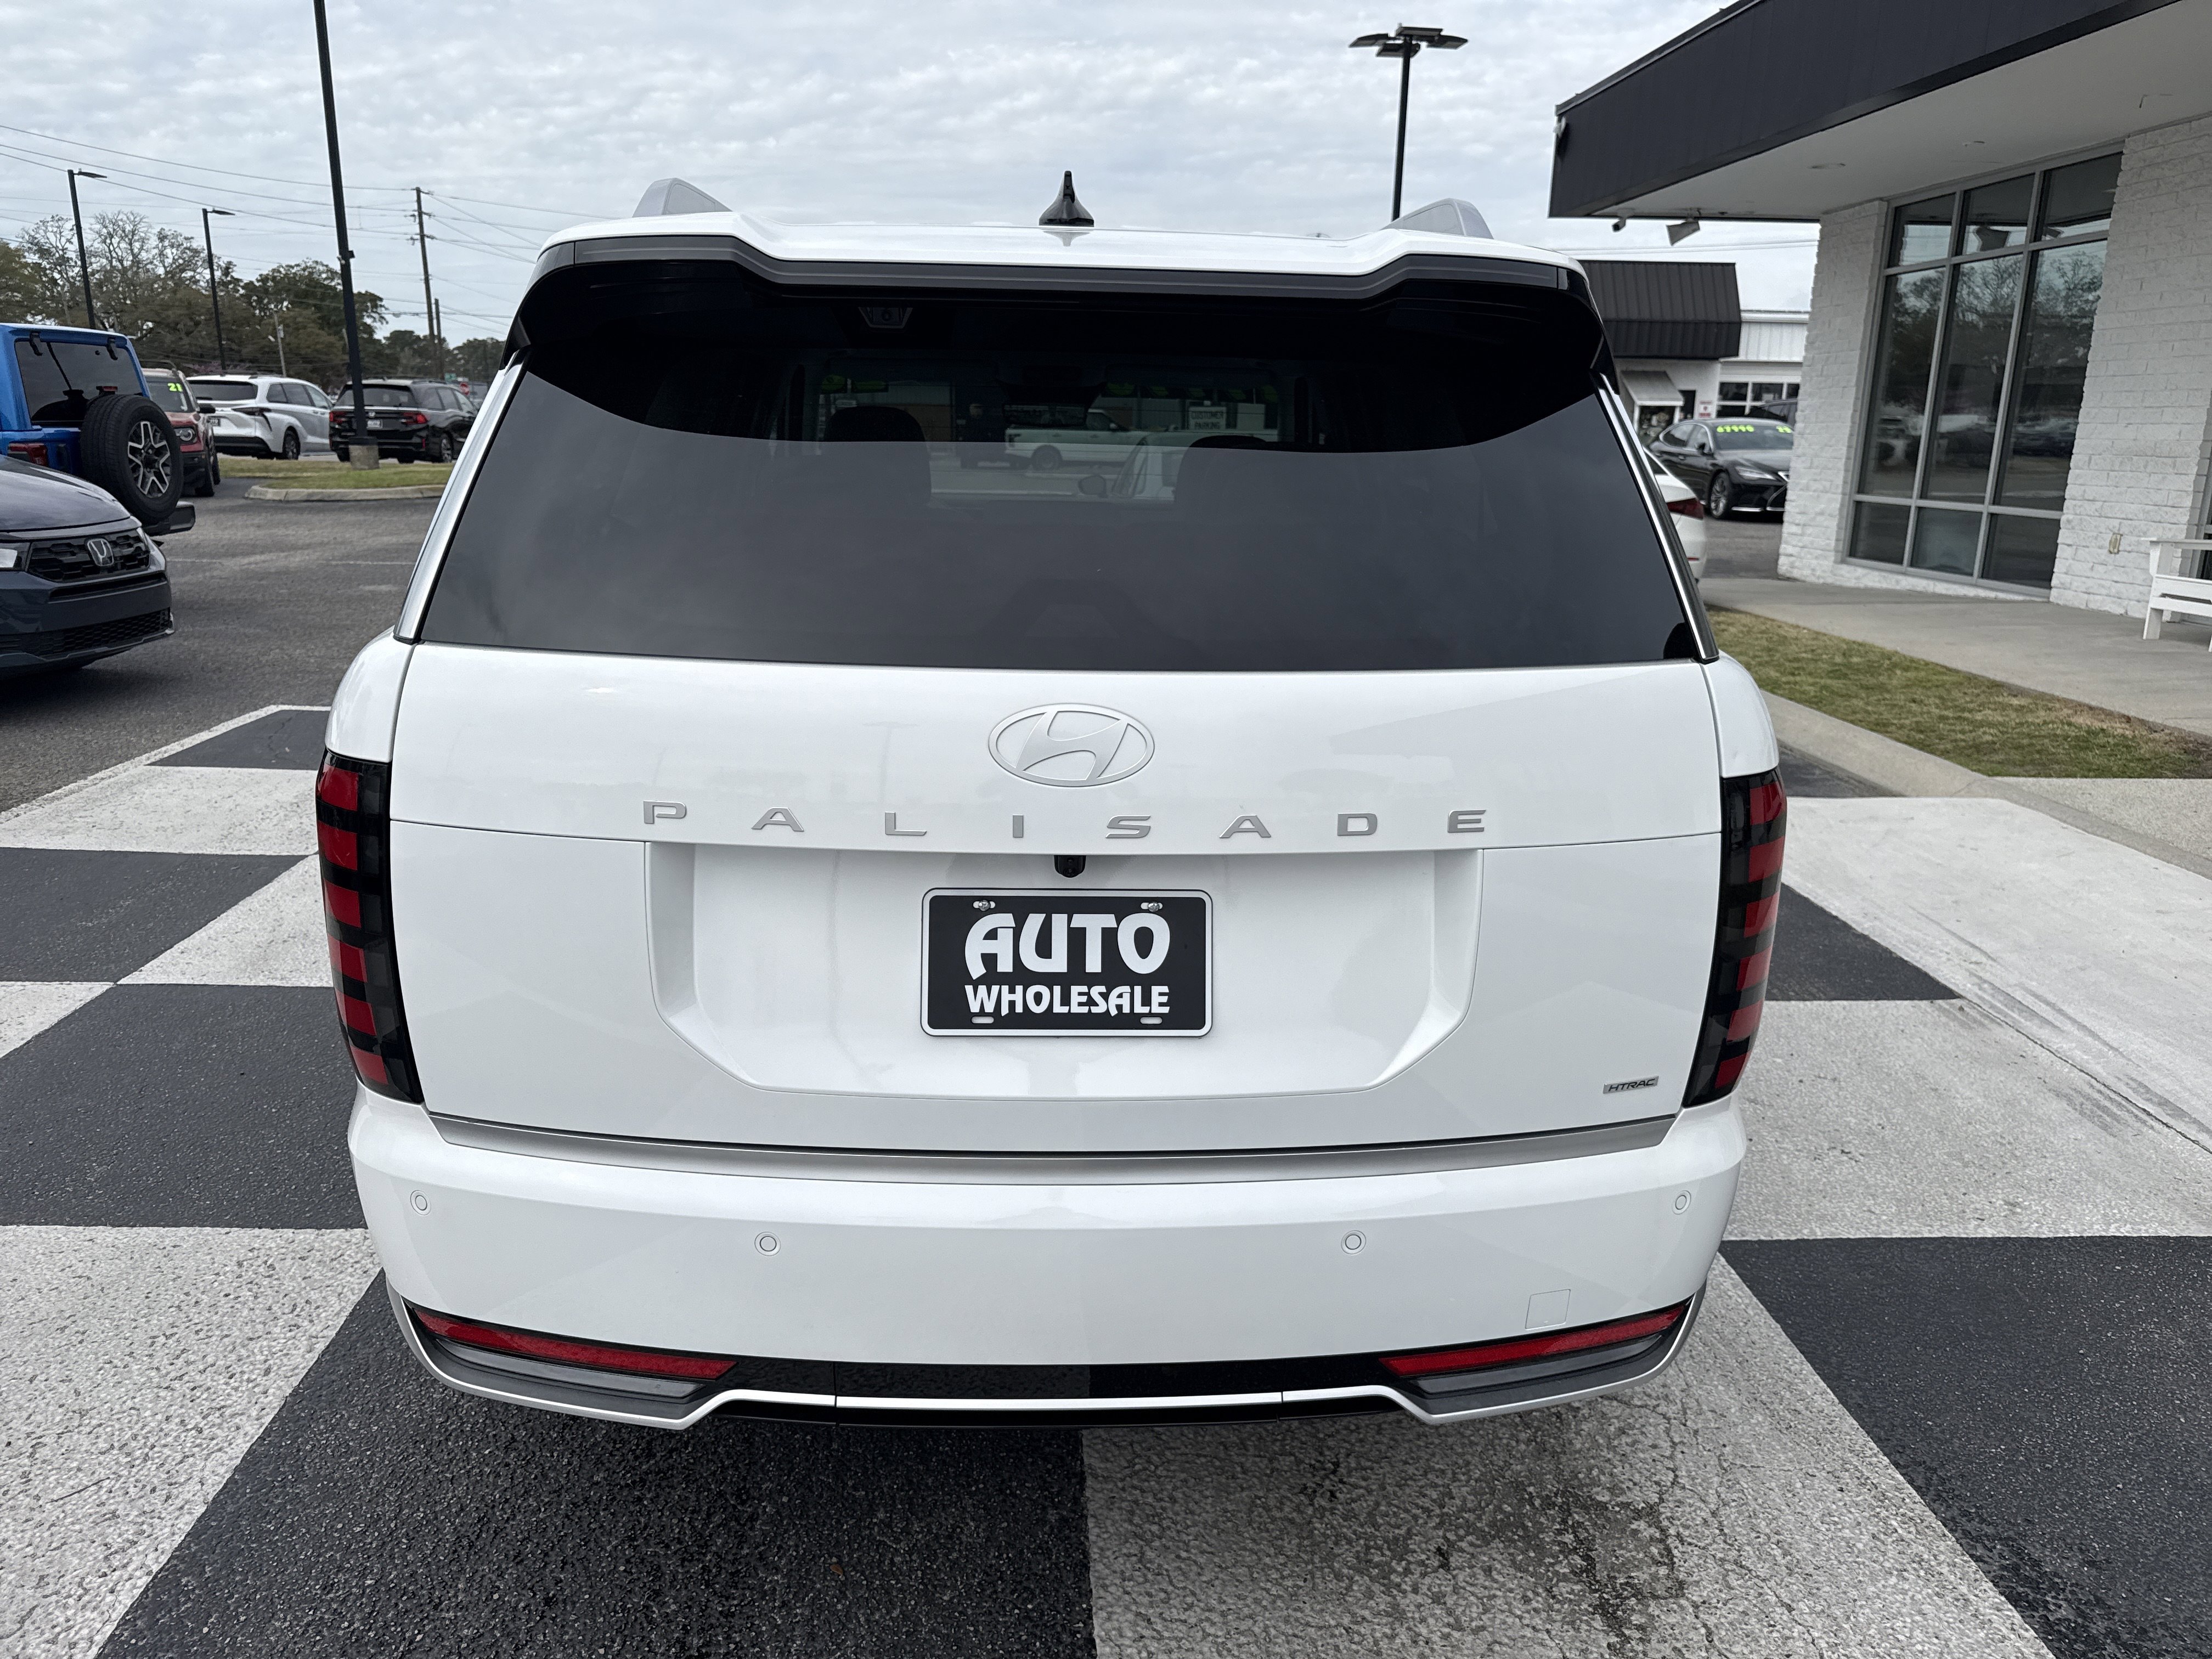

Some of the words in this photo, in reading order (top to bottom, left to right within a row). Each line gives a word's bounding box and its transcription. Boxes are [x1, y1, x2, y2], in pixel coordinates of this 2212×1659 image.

[167, 382, 183, 392] 21
[1190, 410, 1224, 420] CUSTOMER
[1194, 421, 1221, 430] PARKING
[643, 799, 1487, 839] PALISADE
[964, 912, 1171, 980] AUTO
[964, 984, 1171, 1017] WHOLESALE
[1608, 1078, 1656, 1092] HTRAC
